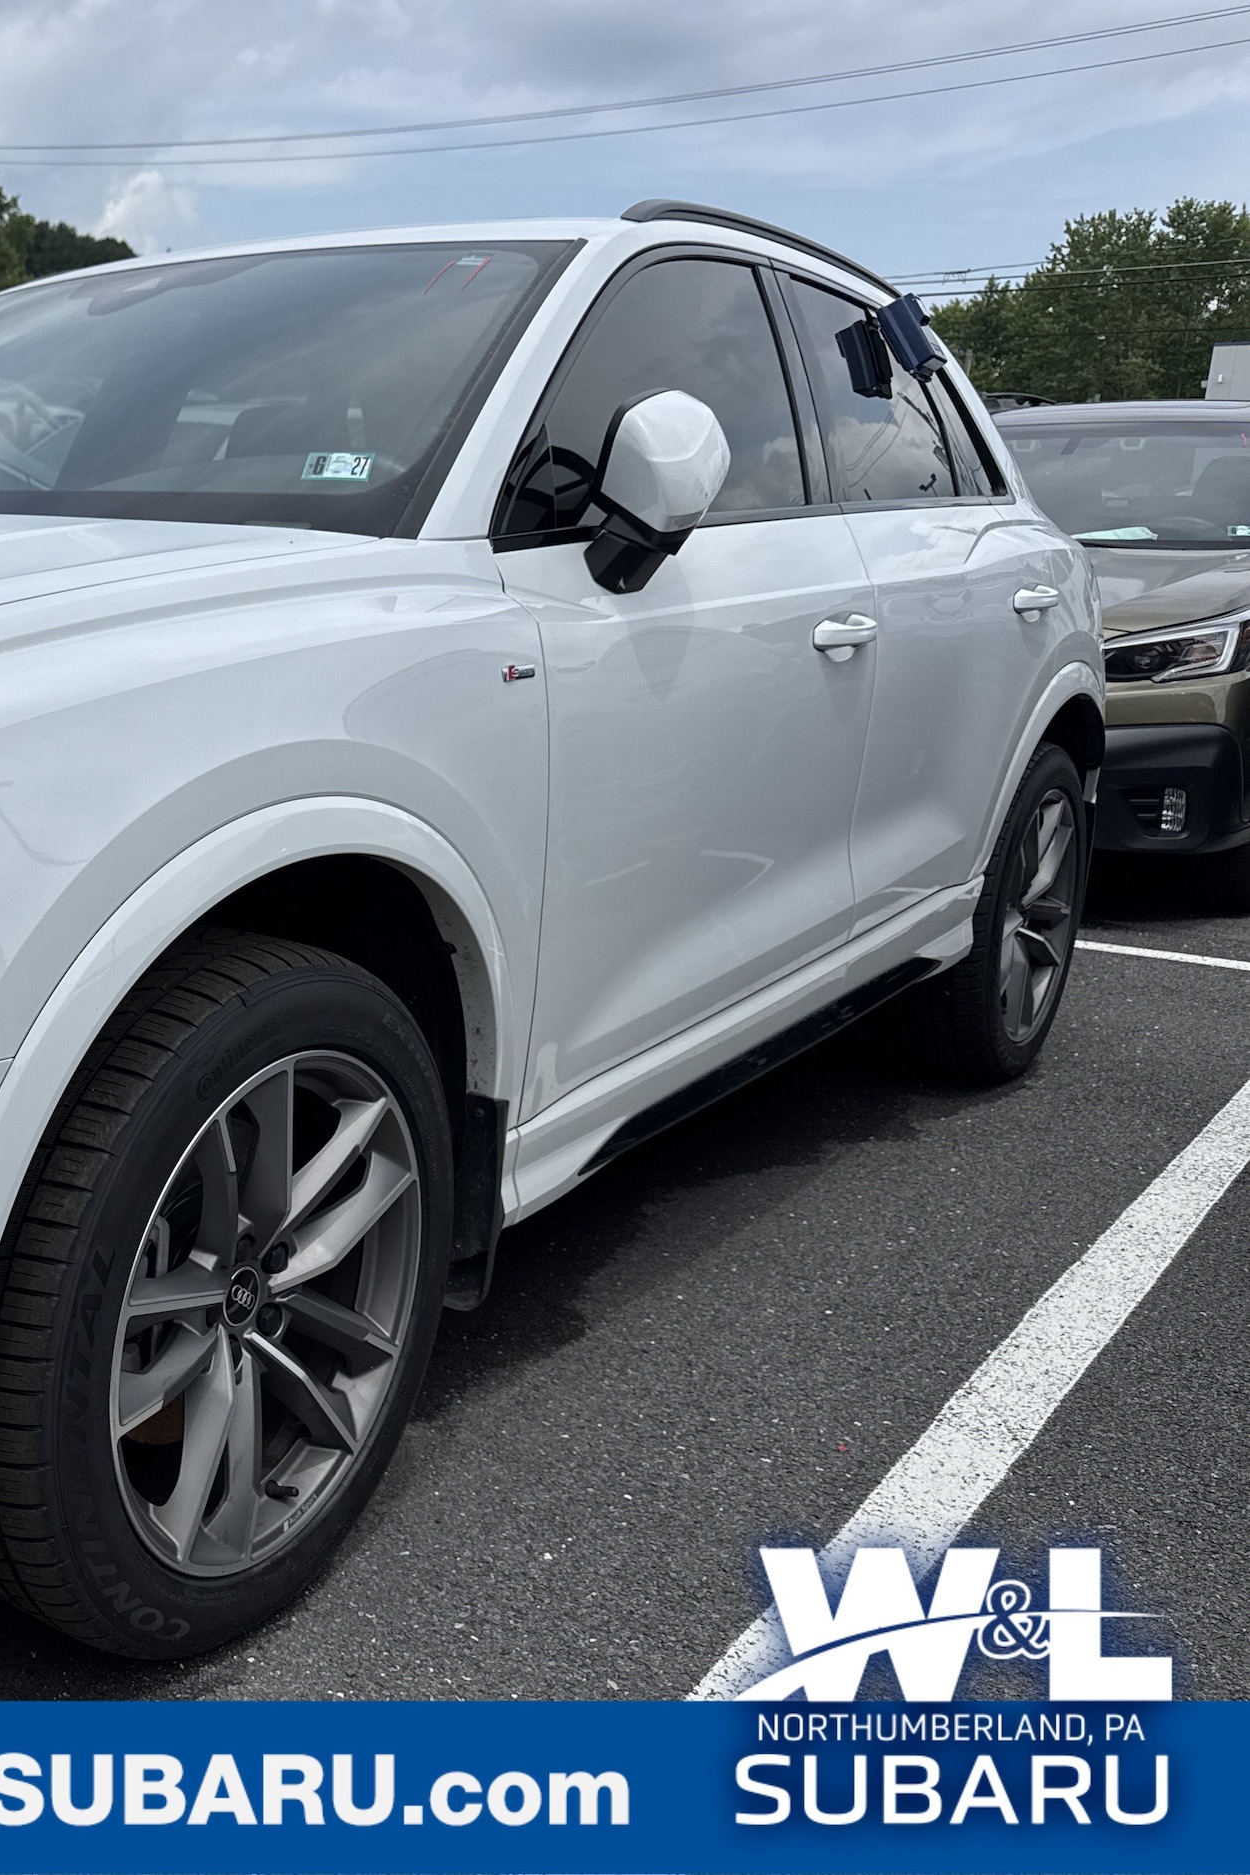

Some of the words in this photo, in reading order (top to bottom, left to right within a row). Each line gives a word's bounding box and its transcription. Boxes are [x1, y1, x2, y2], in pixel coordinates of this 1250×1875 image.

[313, 456, 327, 475] 6
[350, 456, 369, 476] 27
[62, 1247, 191, 1641] CONTINENTAL
